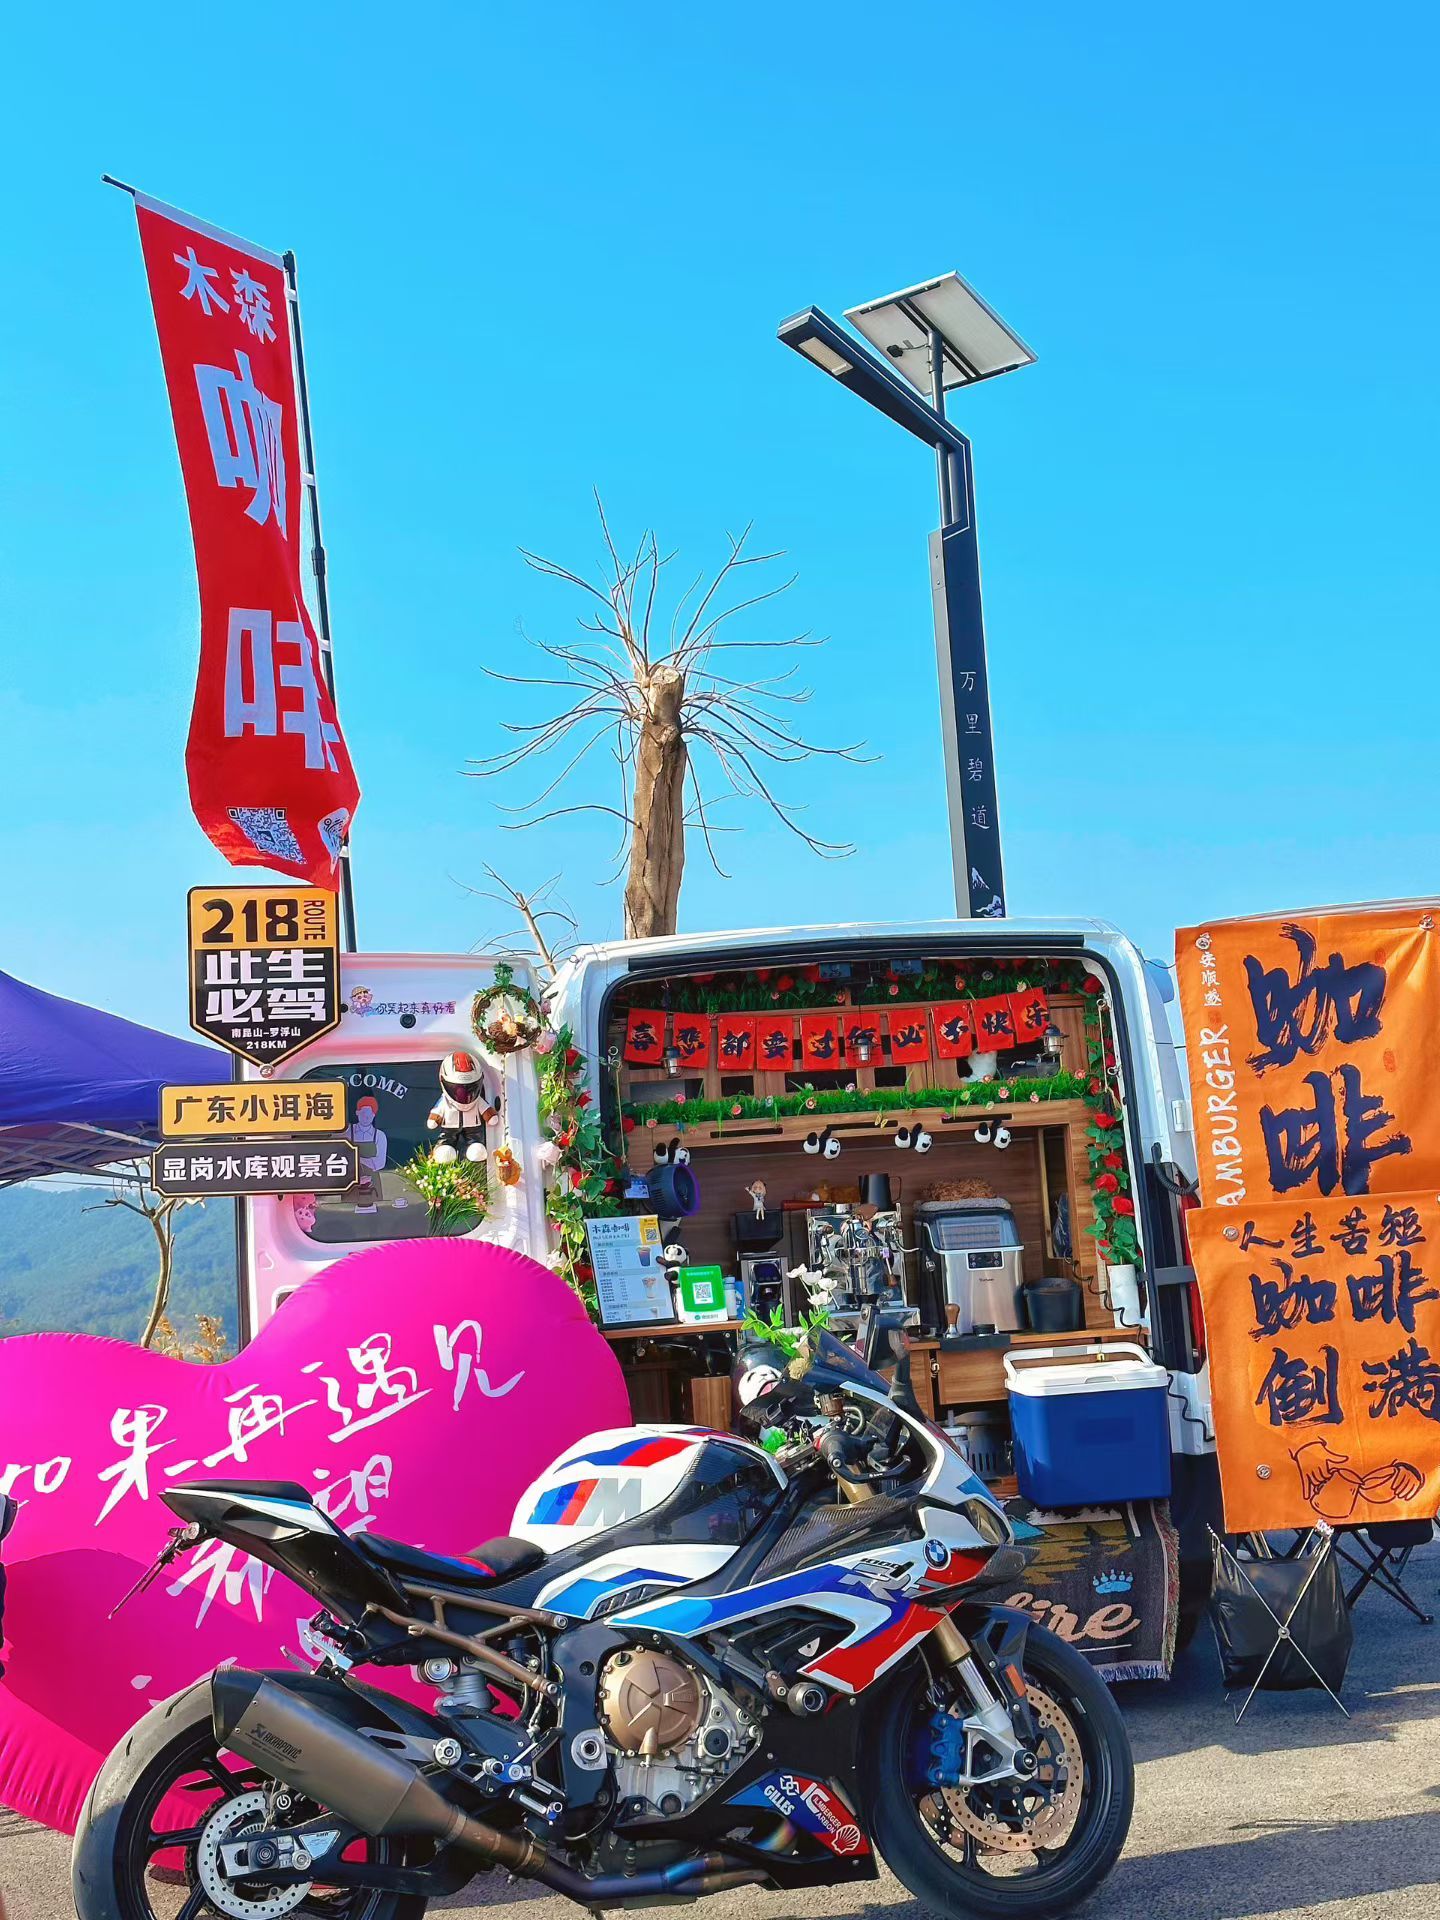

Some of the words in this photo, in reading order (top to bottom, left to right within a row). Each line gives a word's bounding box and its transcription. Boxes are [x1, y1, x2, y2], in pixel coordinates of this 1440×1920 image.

[173, 245, 277, 345] 木森
[959, 671, 991, 830] 万里碧道
[202, 898, 299, 944] 218
[303, 899, 326, 941] ROUTE
[204, 949, 326, 986] 此生
[205, 986, 326, 1024] 必驾
[375, 1001, 456, 1015] 你笑起来真好看
[246, 1040, 287, 1050] 218KM
[1244, 922, 1413, 1197] 咖啡
[173, 1092, 335, 1125] 广东小洱海
[162, 1152, 350, 1182] 显岗水库观景台
[1239, 1204, 1426, 1258] 人生苦短
[1248, 1250, 1440, 1343] 咖啡
[1255, 1336, 1440, 1430] 倒满
[764, 1785, 796, 1816] GILLES
